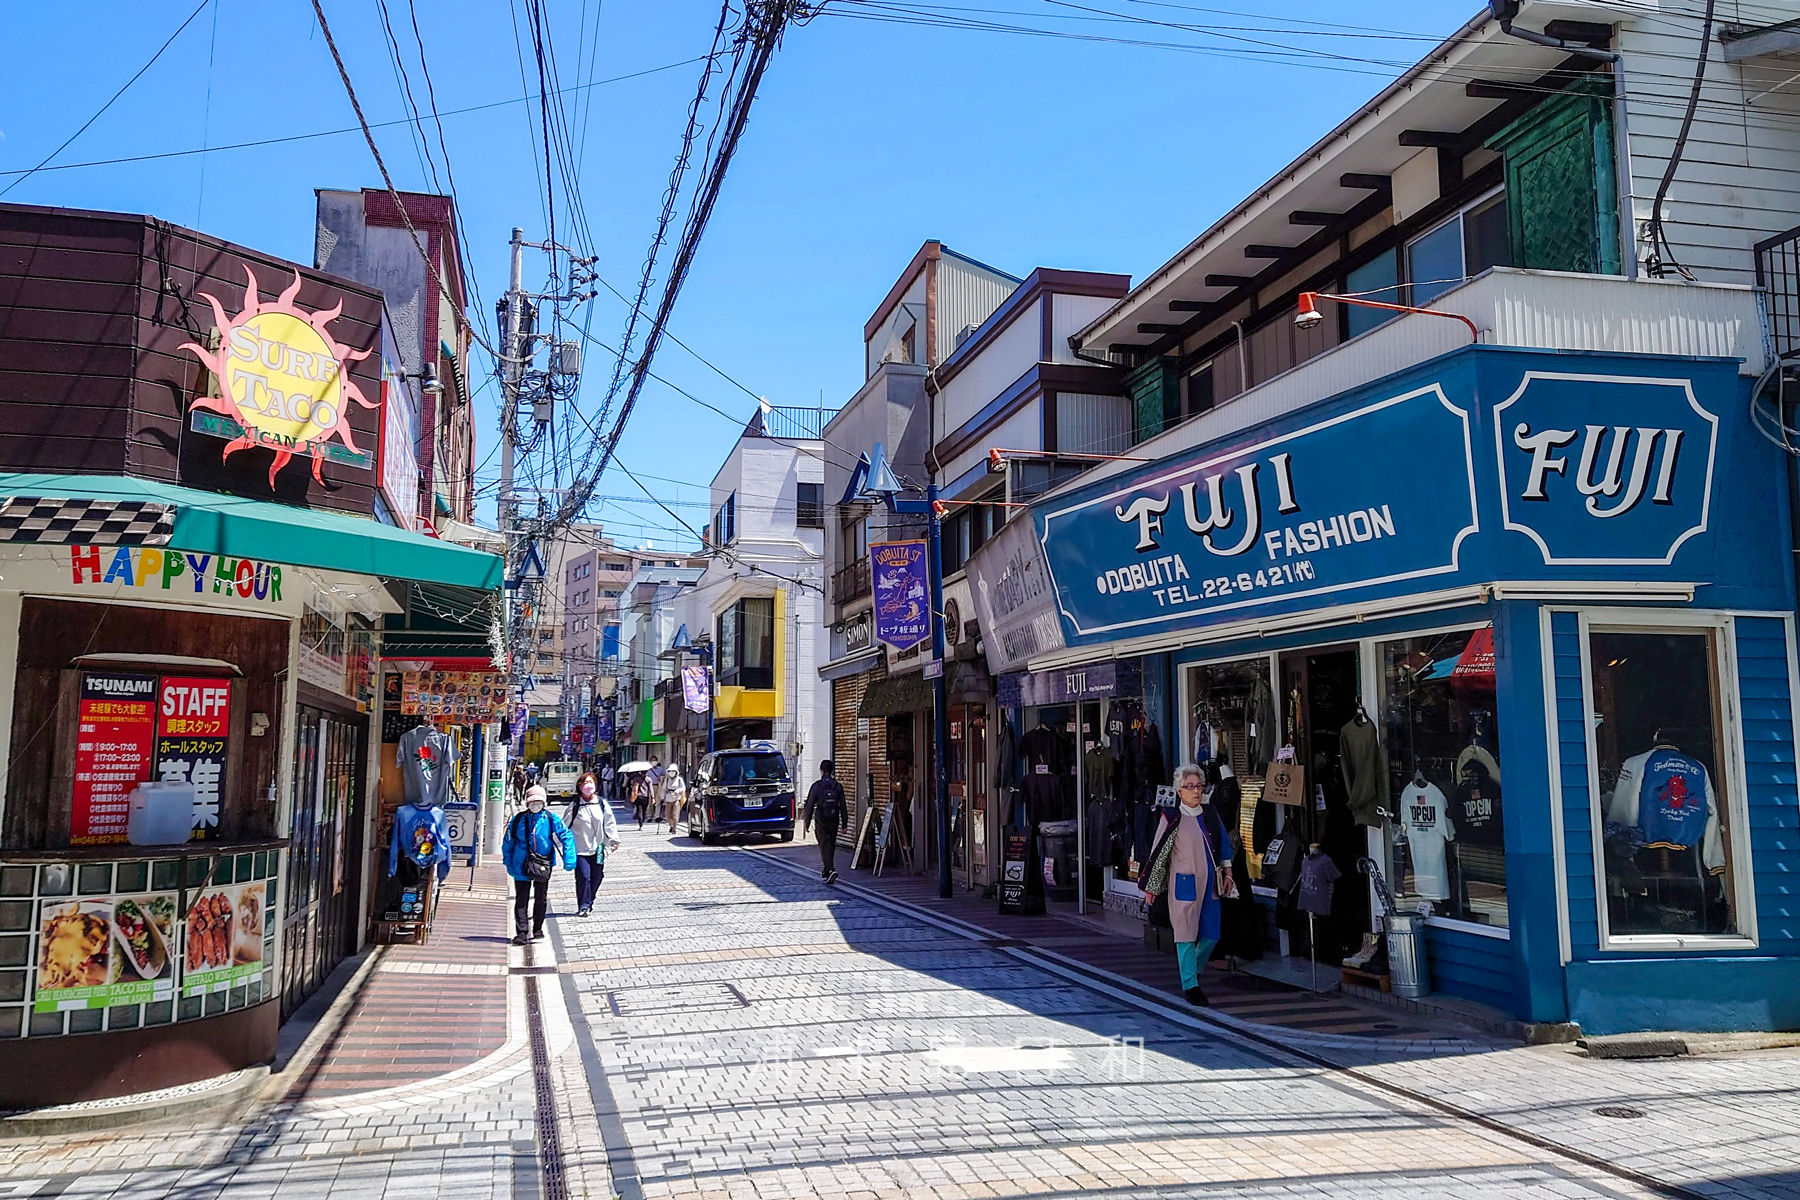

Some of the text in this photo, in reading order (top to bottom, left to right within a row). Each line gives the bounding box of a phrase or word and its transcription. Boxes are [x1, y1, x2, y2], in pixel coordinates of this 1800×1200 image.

[229, 324, 340, 383] SURF
[233, 368, 338, 429] TACO
[202, 416, 366, 465] MEXICAN FOODS
[1513, 422, 1685, 518] FUJI
[1115, 453, 1301, 557] FUJI
[1264, 504, 1396, 560] FASHION
[875, 547, 922, 565] DOBUITA ST
[71, 545, 282, 602] HAPPY HOUR
[1104, 553, 1190, 595] DOBUITA
[847, 620, 869, 645] SIMON
[881, 624, 926, 635] ドブ板通り
[86, 678, 153, 693] TSUNAMI
[1066, 672, 1087, 697] FUJI
[162, 686, 228, 717] STAFF
[166, 719, 221, 733] 調理スタッフ
[160, 740, 224, 754] ホールスタッフ
[490, 786, 502, 798] 文
[448, 825, 458, 838] 6
[110, 983, 135, 996] TACO
[136, 982, 152, 992] BEEF
[184, 973, 214, 986] BUFFALO
